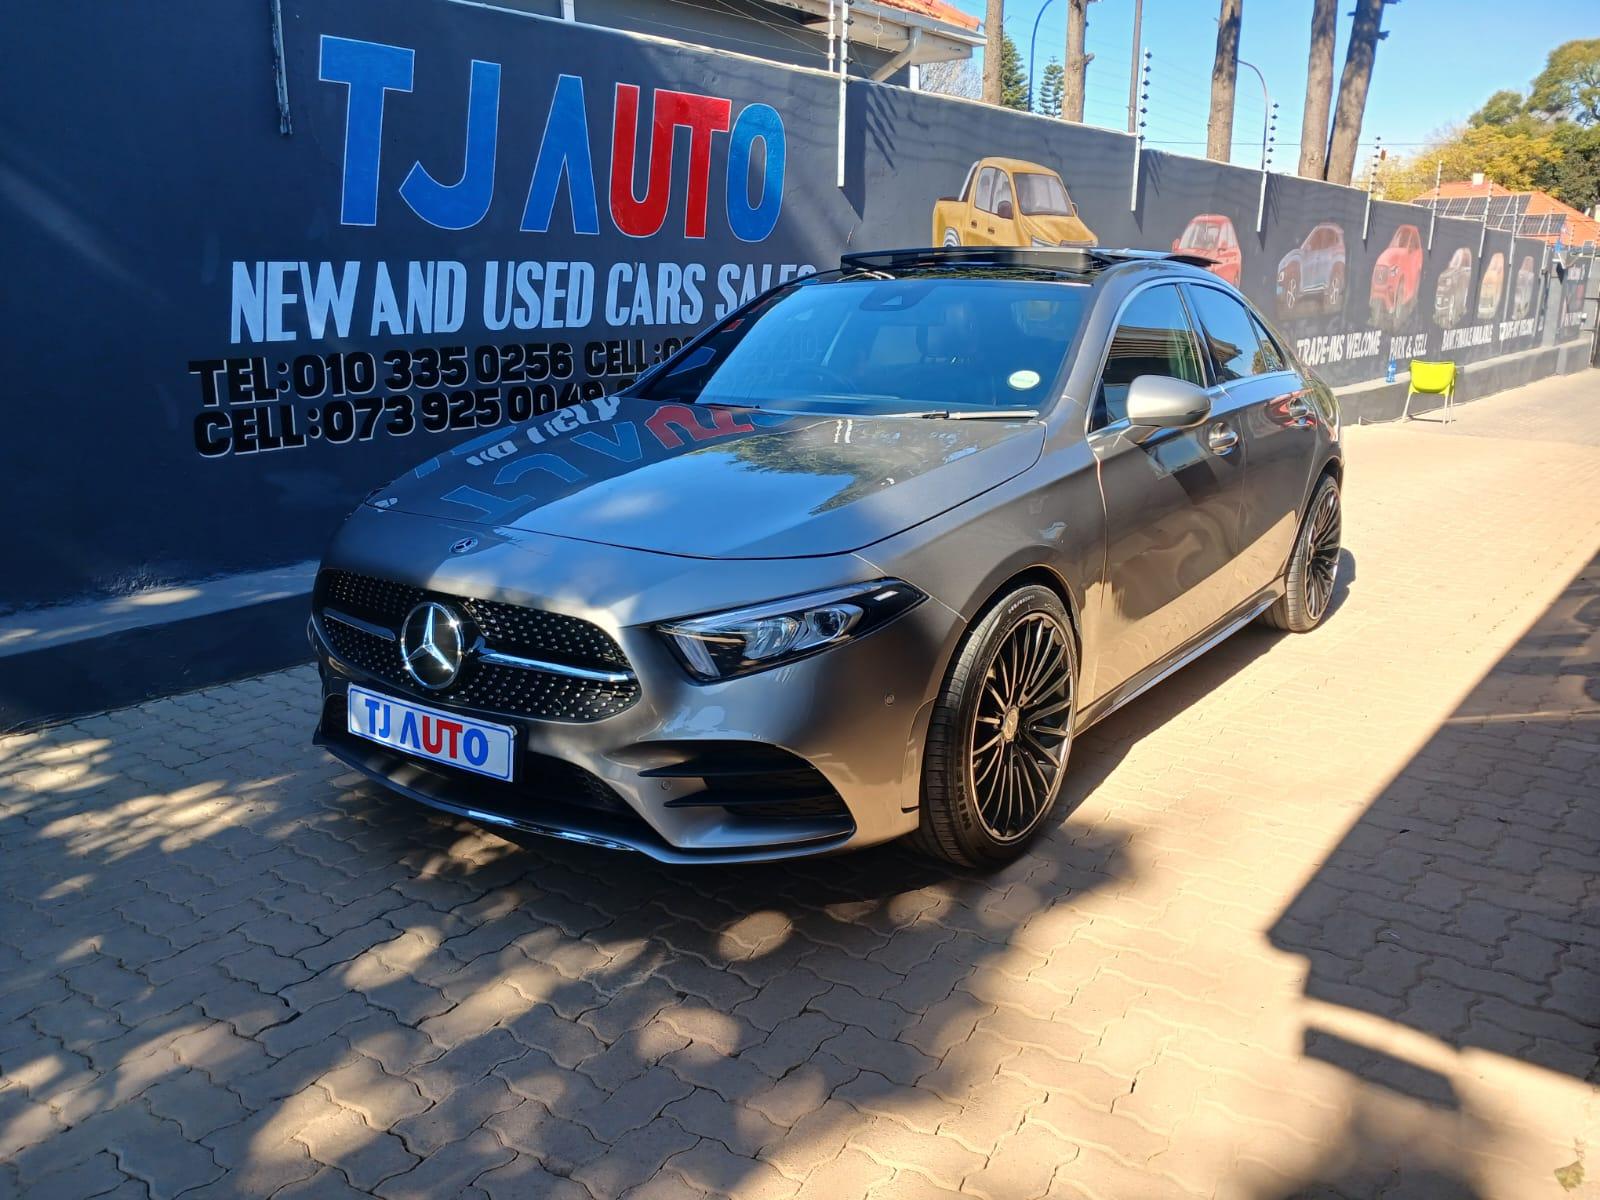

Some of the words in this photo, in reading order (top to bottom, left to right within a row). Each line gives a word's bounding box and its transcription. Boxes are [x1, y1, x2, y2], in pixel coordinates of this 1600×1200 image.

[318, 34, 501, 231] TJ
[519, 74, 787, 242] AUTO
[231, 261, 361, 344] NEW
[370, 261, 468, 336] AND
[483, 260, 595, 331] USED
[605, 262, 706, 326] CARS
[188, 352, 377, 408] TEL:010
[384, 345, 468, 392] 335
[474, 341, 573, 384] 0256
[1297, 334, 1345, 367] TRADE-INS
[1345, 330, 1382, 360] WELCOME
[194, 395, 415, 458] CELL:073
[421, 388, 502, 433] 925
[365, 698, 391, 738] TJ
[400, 711, 489, 766] AUTO
